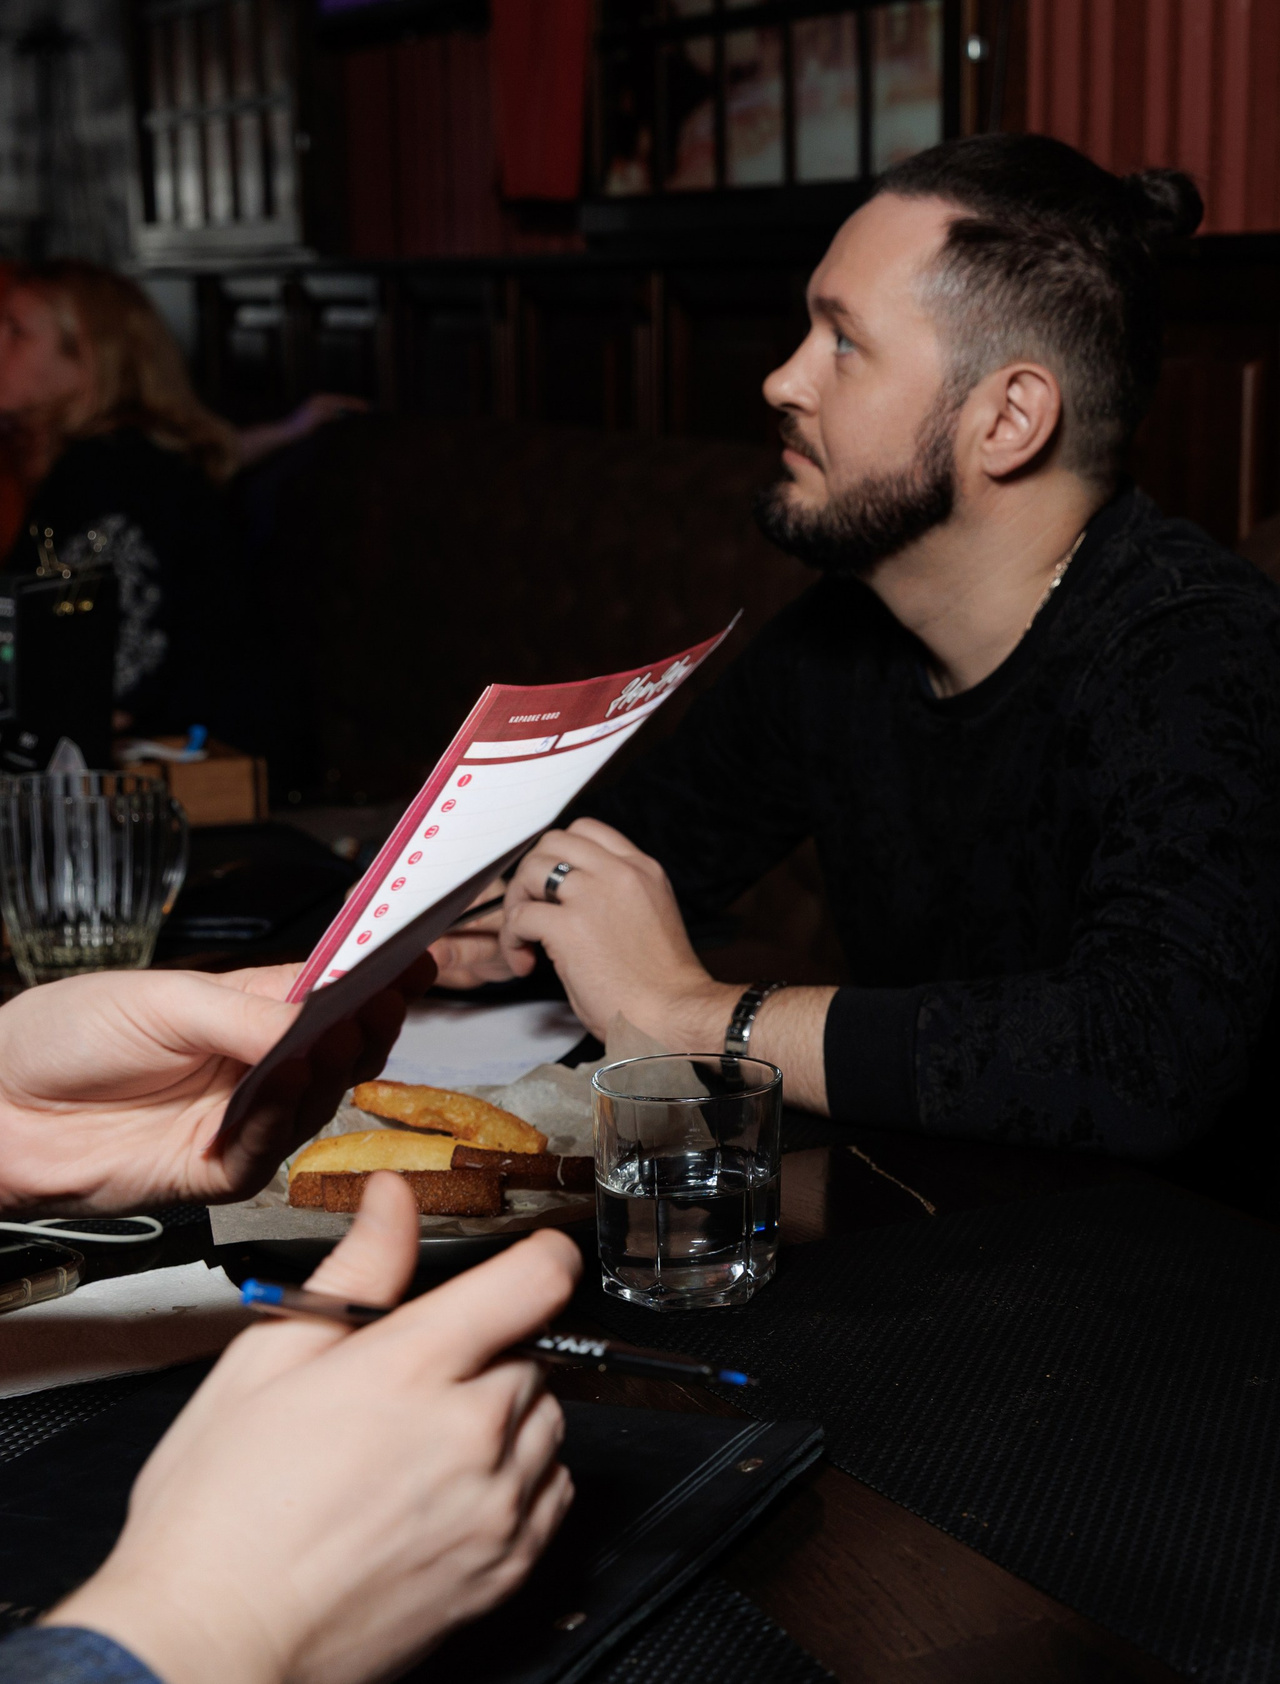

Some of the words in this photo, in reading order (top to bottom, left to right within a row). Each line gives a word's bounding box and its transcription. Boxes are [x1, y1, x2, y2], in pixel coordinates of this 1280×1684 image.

[508, 713, 541, 724] КАРАОКЕ
[441, 799, 456, 812] 2
[425, 825, 439, 839] 3
[409, 851, 422, 864] 4
[391, 877, 406, 891] 5
[374, 904, 389, 918] 6
[358, 931, 372, 944] 7
